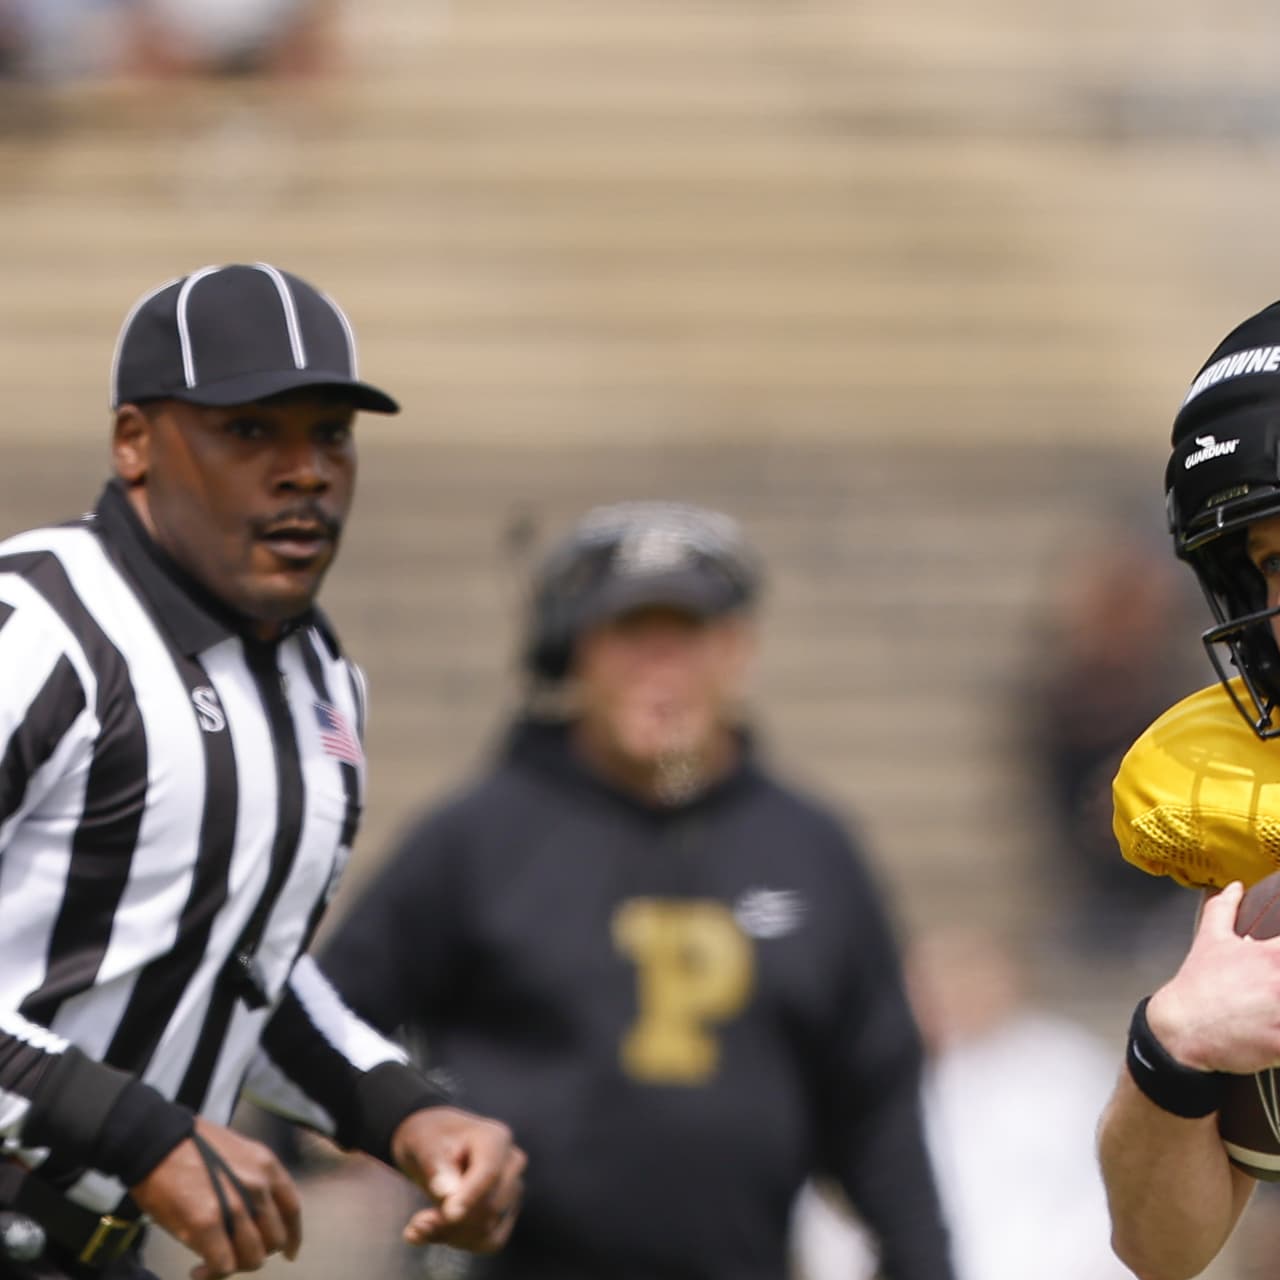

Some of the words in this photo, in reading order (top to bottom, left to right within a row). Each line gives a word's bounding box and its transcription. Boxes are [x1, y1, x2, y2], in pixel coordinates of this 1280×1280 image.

[1184, 441, 1237, 470] GUARDIAN
[192, 686, 225, 732] S
[613, 898, 756, 1084] P
